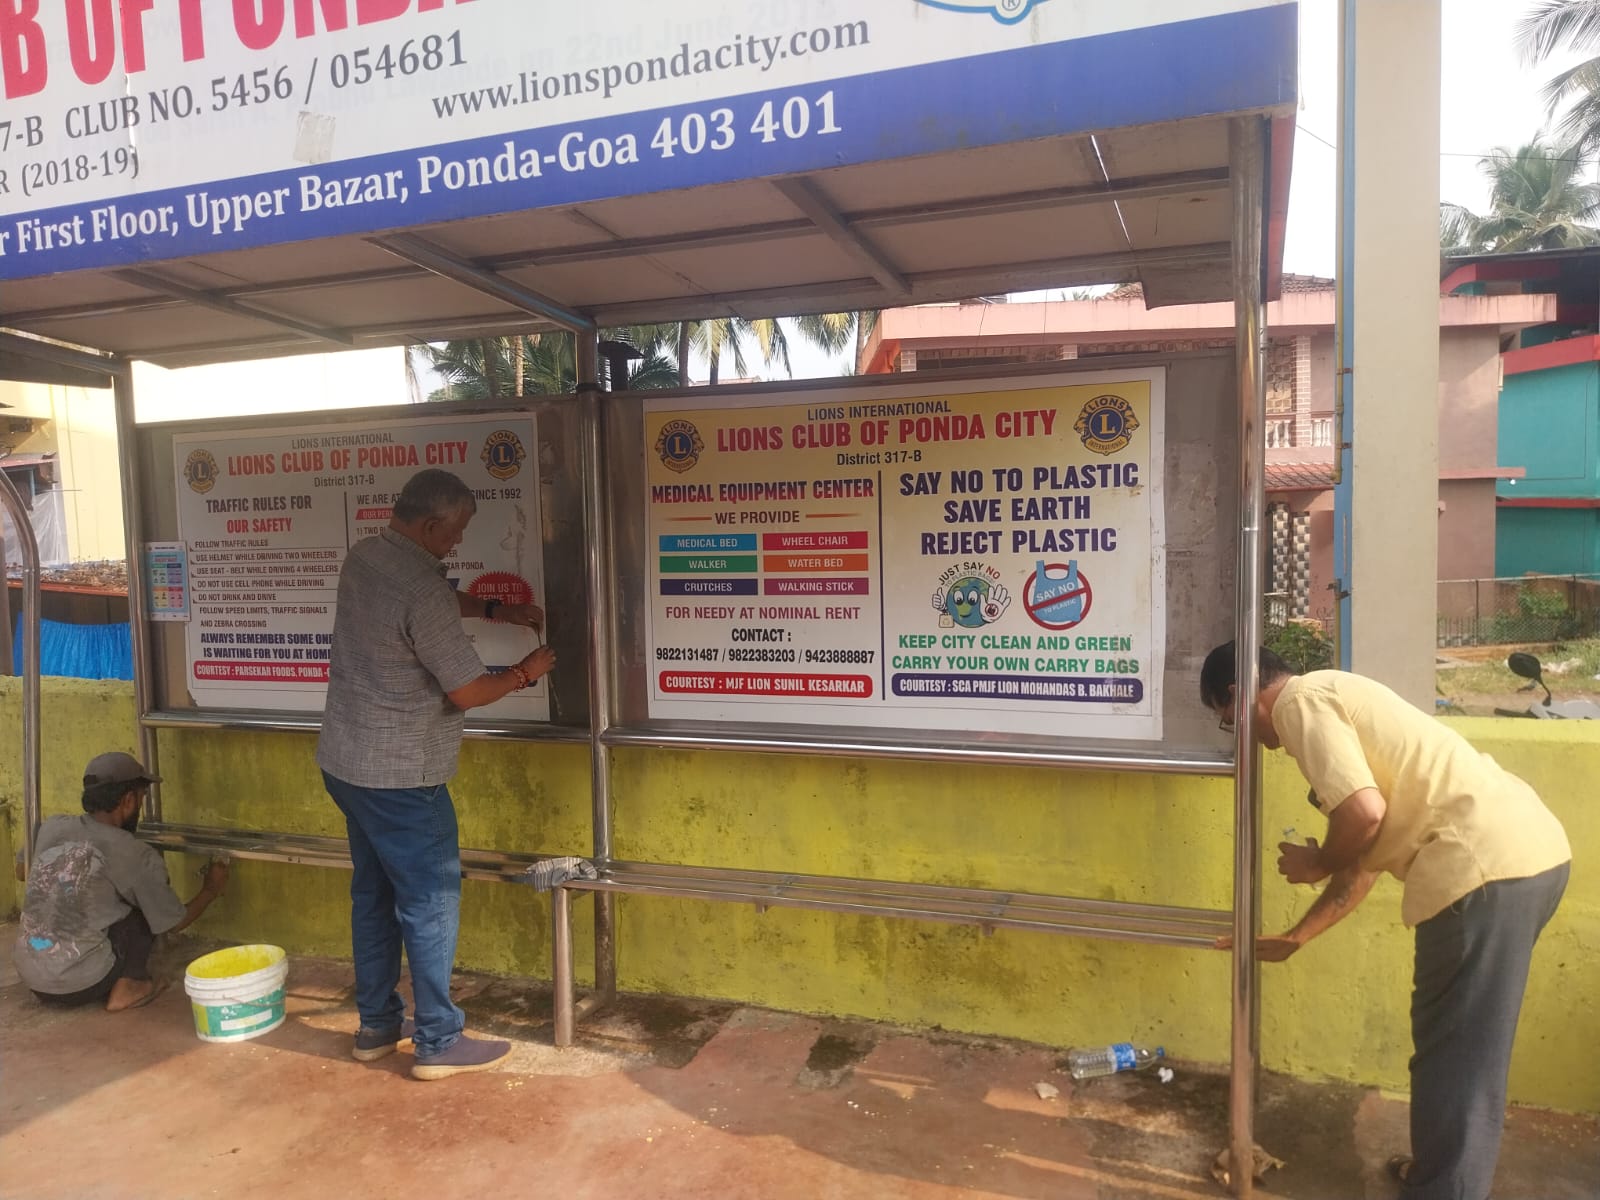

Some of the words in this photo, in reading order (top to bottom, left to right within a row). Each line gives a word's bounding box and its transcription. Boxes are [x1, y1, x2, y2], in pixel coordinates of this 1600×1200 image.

[432, 20, 870, 118] www.lionspondacity.com
[65, 95, 140, 139] CLUB
[149, 84, 202, 125] NO.
[211, 64, 294, 112] 5456
[304, 57, 318, 105] /
[330, 29, 468, 90] 054681
[15, 215, 86, 254] First
[90, 205, 179, 243] Floor,
[186, 183, 291, 238] Upper
[298, 168, 409, 215] Bazar,
[417, 129, 640, 196] Ponda-Goa
[651, 107, 736, 161] 403
[750, 91, 843, 142] 401
[21, 145, 140, 197] (2018-19)
[807, 408, 845, 421] LIONS
[849, 400, 952, 418] INTERNATIONAL
[1087, 397, 1127, 411] LIONS
[664, 422, 695, 434] LIONS
[717, 426, 784, 452] LIONS
[791, 422, 851, 449] CLUB
[860, 420, 890, 446] OF
[898, 413, 986, 444] PONDA
[995, 409, 1057, 438] CITY
[291, 438, 319, 450] LIONS
[321, 432, 395, 448] INTERNATIONAL
[228, 453, 276, 476] LIONS
[281, 450, 325, 473] CLUB
[330, 449, 351, 471] OF
[357, 443, 421, 469] PONDA
[425, 440, 468, 465] CITY
[837, 453, 881, 466] District
[884, 450, 922, 464] 317-B
[314, 477, 346, 488] District
[347, 474, 375, 486] 317-B
[899, 471, 942, 496] SAY
[951, 469, 983, 494] NO
[992, 468, 1023, 492] TO
[1033, 462, 1139, 491] PLASTIC
[499, 488, 521, 500] 1992
[652, 484, 714, 504] MEDICAL
[719, 481, 807, 504] EQUIPMENT
[813, 478, 874, 499] CENTER
[206, 498, 249, 513] TRAFFIC
[253, 496, 287, 511] RULES
[290, 495, 312, 510] FOR
[357, 494, 370, 505] WE
[372, 494, 389, 504] ARE
[714, 512, 736, 524] WE
[741, 511, 800, 524] PROVIDE
[943, 498, 1002, 523] SAVE
[1011, 496, 1091, 522] EARTH
[227, 519, 249, 534] OUR
[252, 518, 293, 532] SAFETY
[677, 538, 717, 548] MEDICAL
[719, 538, 738, 547] BED
[782, 537, 816, 546] WHEEL
[818, 535, 848, 545] CHAIR
[921, 531, 1002, 555] REJECT
[1012, 527, 1117, 554] PLASTIC
[688, 559, 727, 569] WALKER
[788, 558, 822, 568] WATER
[824, 558, 844, 567] BED
[939, 564, 960, 586] JUST
[963, 561, 984, 571] SAY
[985, 565, 1001, 580] NO
[684, 582, 733, 592] CRUTCHES
[778, 582, 823, 592] WALKING
[825, 581, 855, 591] STICK
[665, 607, 691, 619] FOR
[694, 607, 736, 619] NEEDY
[739, 607, 755, 619] AT
[759, 607, 821, 619] NOMINAL
[825, 607, 861, 619] RENT
[200, 633, 235, 644] ALWAYS
[236, 633, 286, 645] REMEMBER
[287, 633, 314, 645] SOME
[731, 628, 785, 642] CONTACT
[898, 634, 937, 649] KEEP
[941, 634, 976, 649] CITY
[980, 635, 1032, 650] CLEAN
[1036, 636, 1071, 651] AND
[1074, 636, 1132, 652] GREEN
[203, 648, 212, 658] IS
[213, 648, 252, 658] WAITING
[254, 648, 271, 659] FOR
[272, 648, 291, 659] YOU
[293, 648, 304, 659] AT
[656, 648, 719, 662] 9822131487
[728, 648, 796, 663] 9822383203
[805, 650, 875, 664] 9423888887
[196, 665, 231, 676] COURTESY
[235, 665, 270, 677] PARSEKAR
[298, 666, 323, 678] PONDA
[892, 655, 942, 670] CARRY
[946, 656, 989, 671] YOUR
[993, 657, 1030, 672] OWN
[1034, 658, 1090, 673] CARRY
[1094, 658, 1140, 674] BAGS
[665, 676, 716, 689] COURTESY
[725, 677, 744, 690] MJF
[747, 677, 771, 690] LION
[774, 678, 805, 691] SUNIL
[808, 679, 865, 693] KESARKAR
[899, 678, 947, 692] COURTESY
[952, 679, 972, 693] SCA
[972, 680, 997, 693] PMJF
[997, 681, 1020, 694] LION
[1020, 682, 1076, 696] MOHANDAS
[1077, 683, 1088, 697] B.
[1089, 683, 1134, 698] BAKHALE
